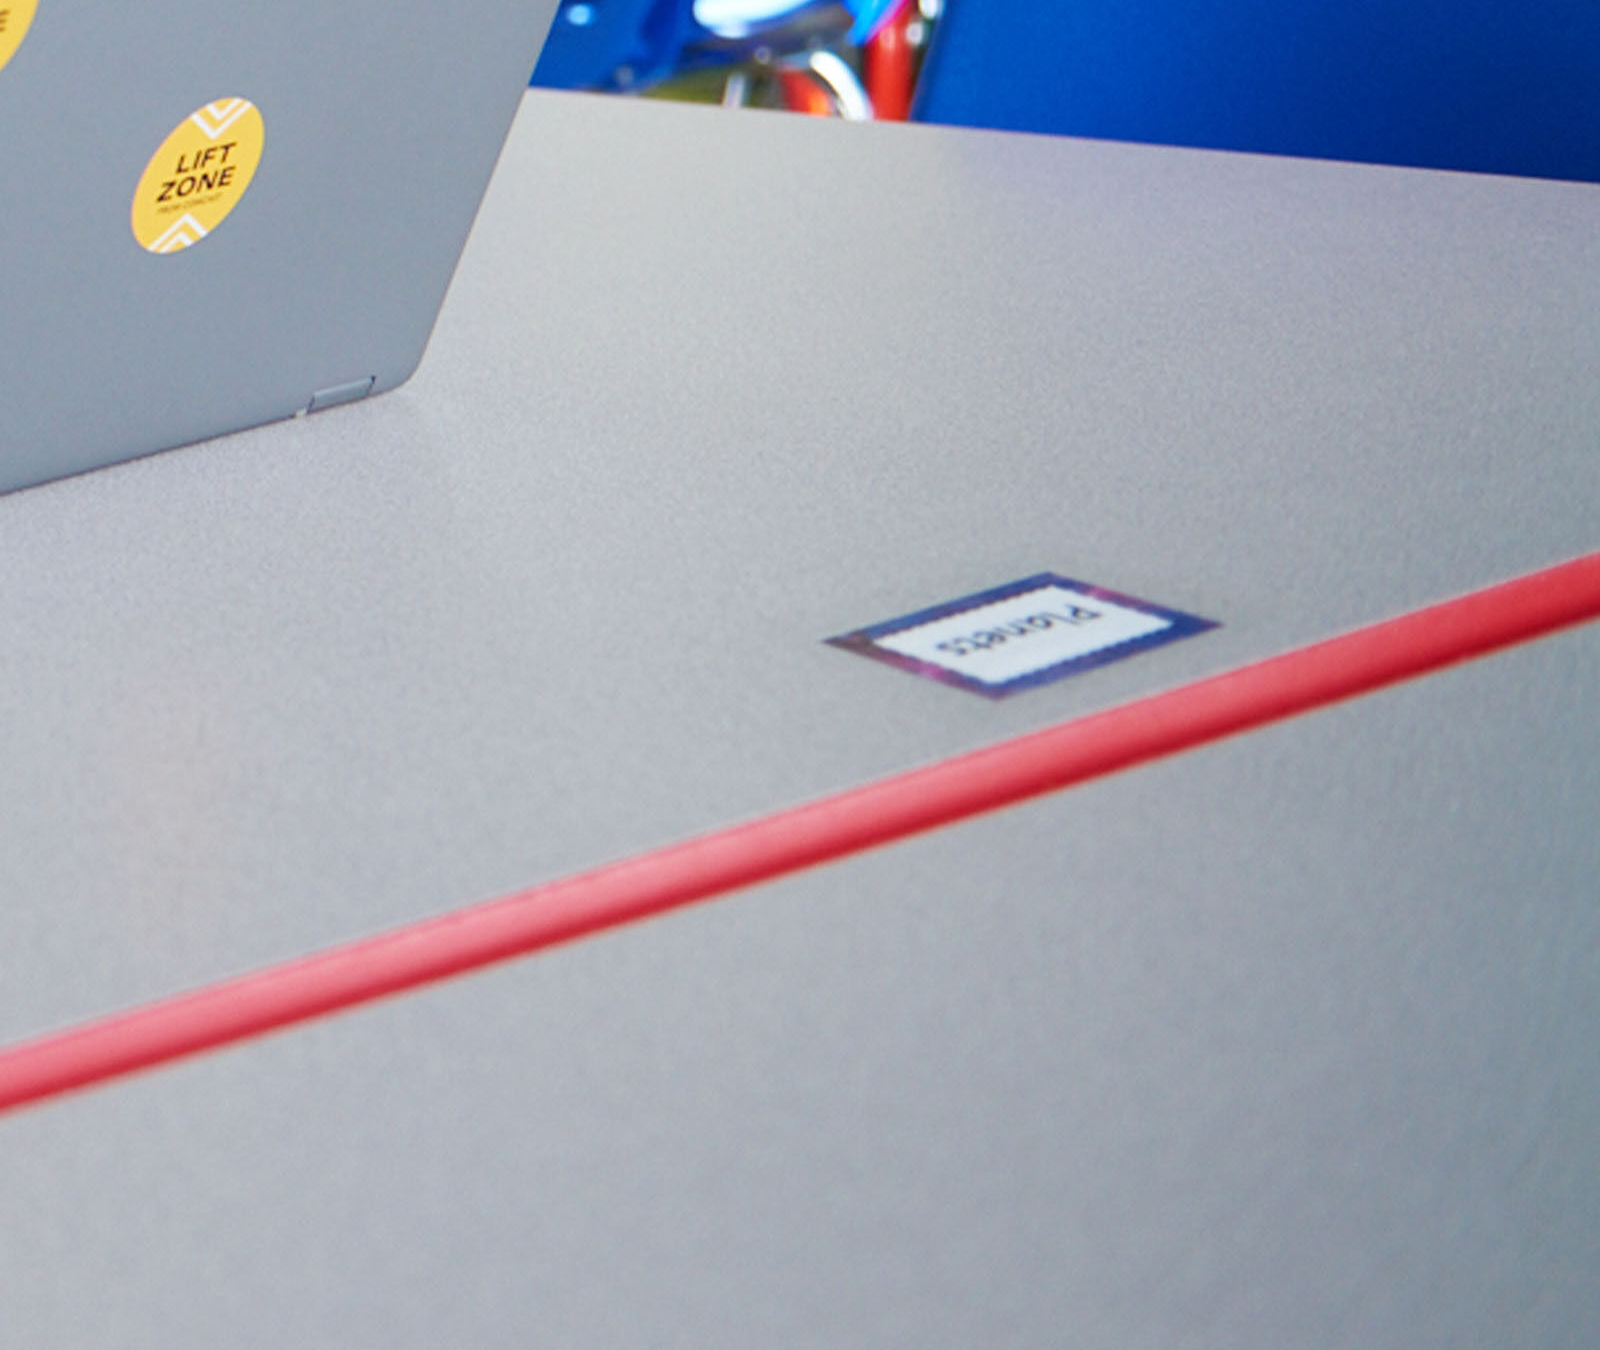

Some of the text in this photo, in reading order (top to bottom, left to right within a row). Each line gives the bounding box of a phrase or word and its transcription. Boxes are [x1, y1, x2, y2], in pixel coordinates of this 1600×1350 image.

[176, 141, 237, 174] LIFT
[156, 165, 236, 202] ZONE
[936, 603, 1102, 655] Planets
